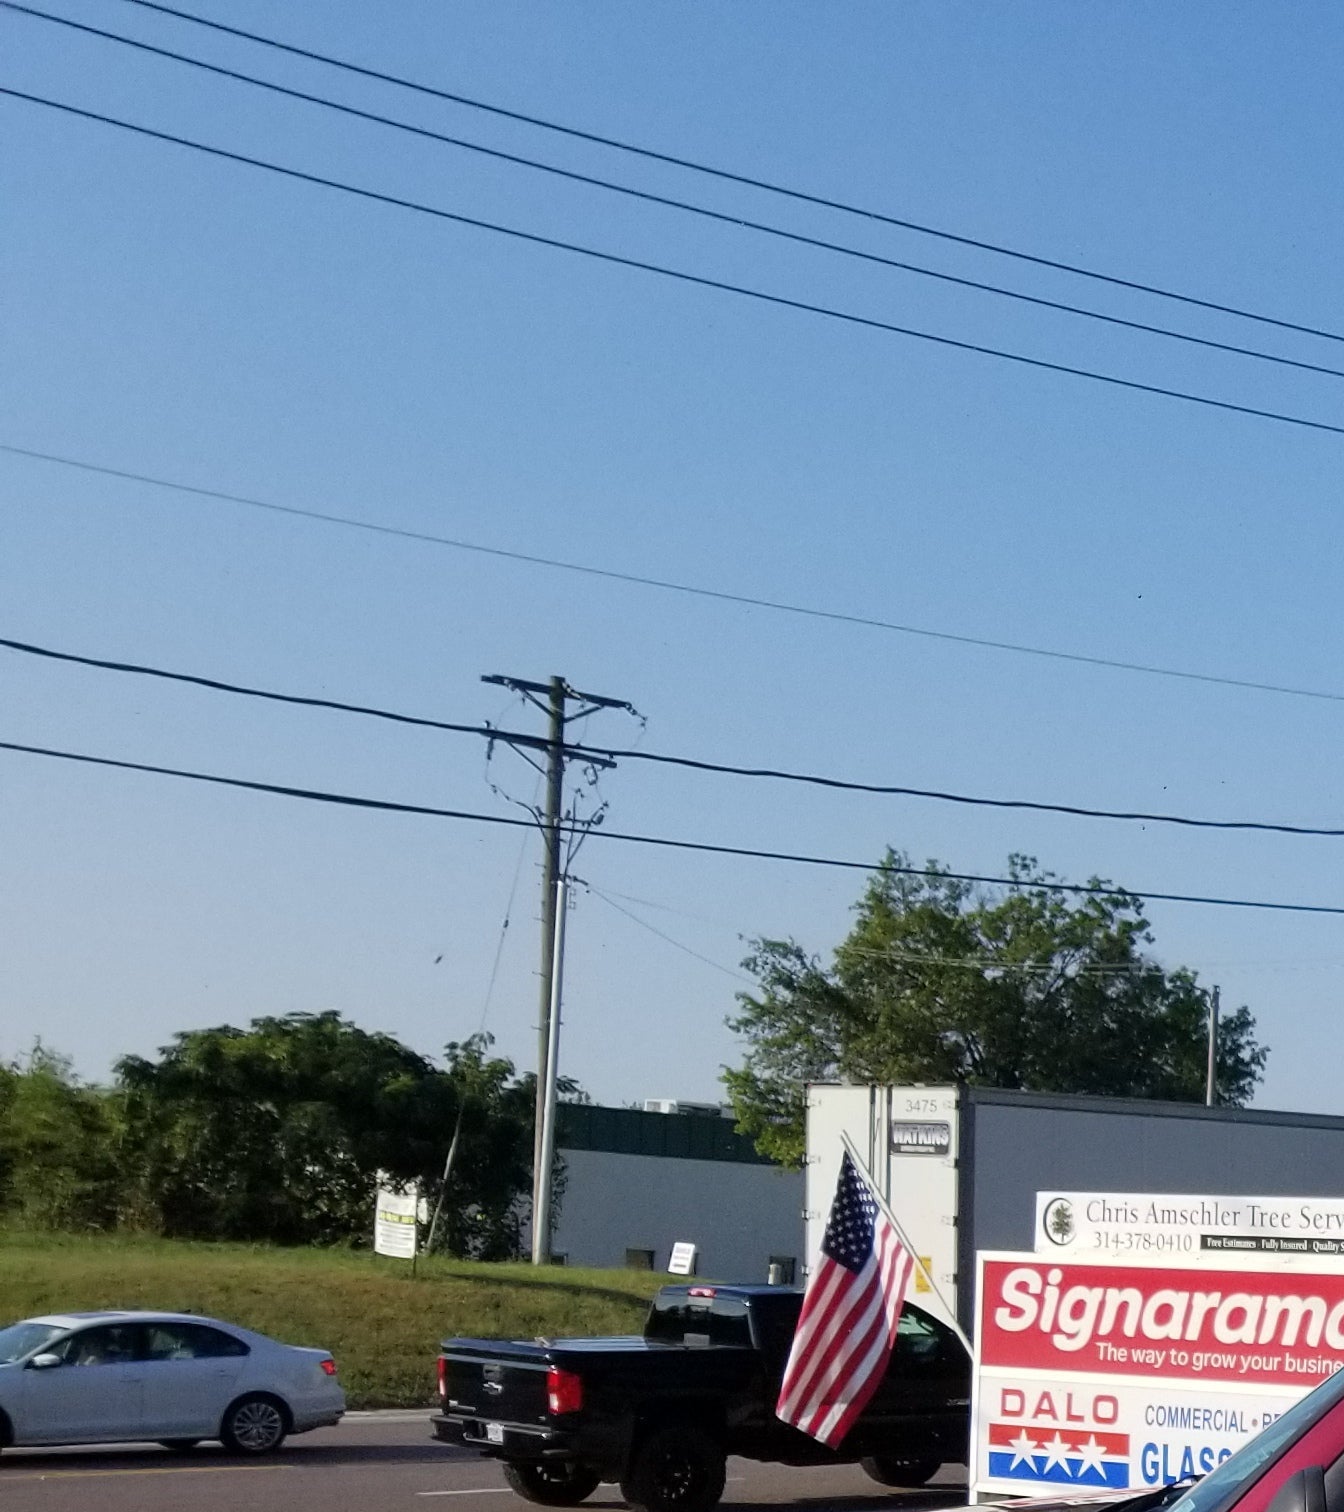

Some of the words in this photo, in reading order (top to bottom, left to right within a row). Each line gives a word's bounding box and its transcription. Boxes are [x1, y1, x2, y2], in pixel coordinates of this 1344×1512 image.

[904, 1098, 938, 1113] 3475
[1086, 1199, 1139, 1224] Chris
[1144, 1201, 1241, 1227] Amschler
[1246, 1204, 1291, 1228] Tree
[1093, 1231, 1193, 1252] 314-378-0410
[1312, 1240, 1340, 1255] Quality
[1095, 1341, 1128, 1362] The
[1131, 1348, 1167, 1369] way
[1170, 1348, 1189, 1366] to
[1192, 1351, 1237, 1372] grow
[1239, 1355, 1282, 1374] your
[1000, 1388, 1120, 1425] DALO
[1144, 1404, 1249, 1433] COMMERCIAL
